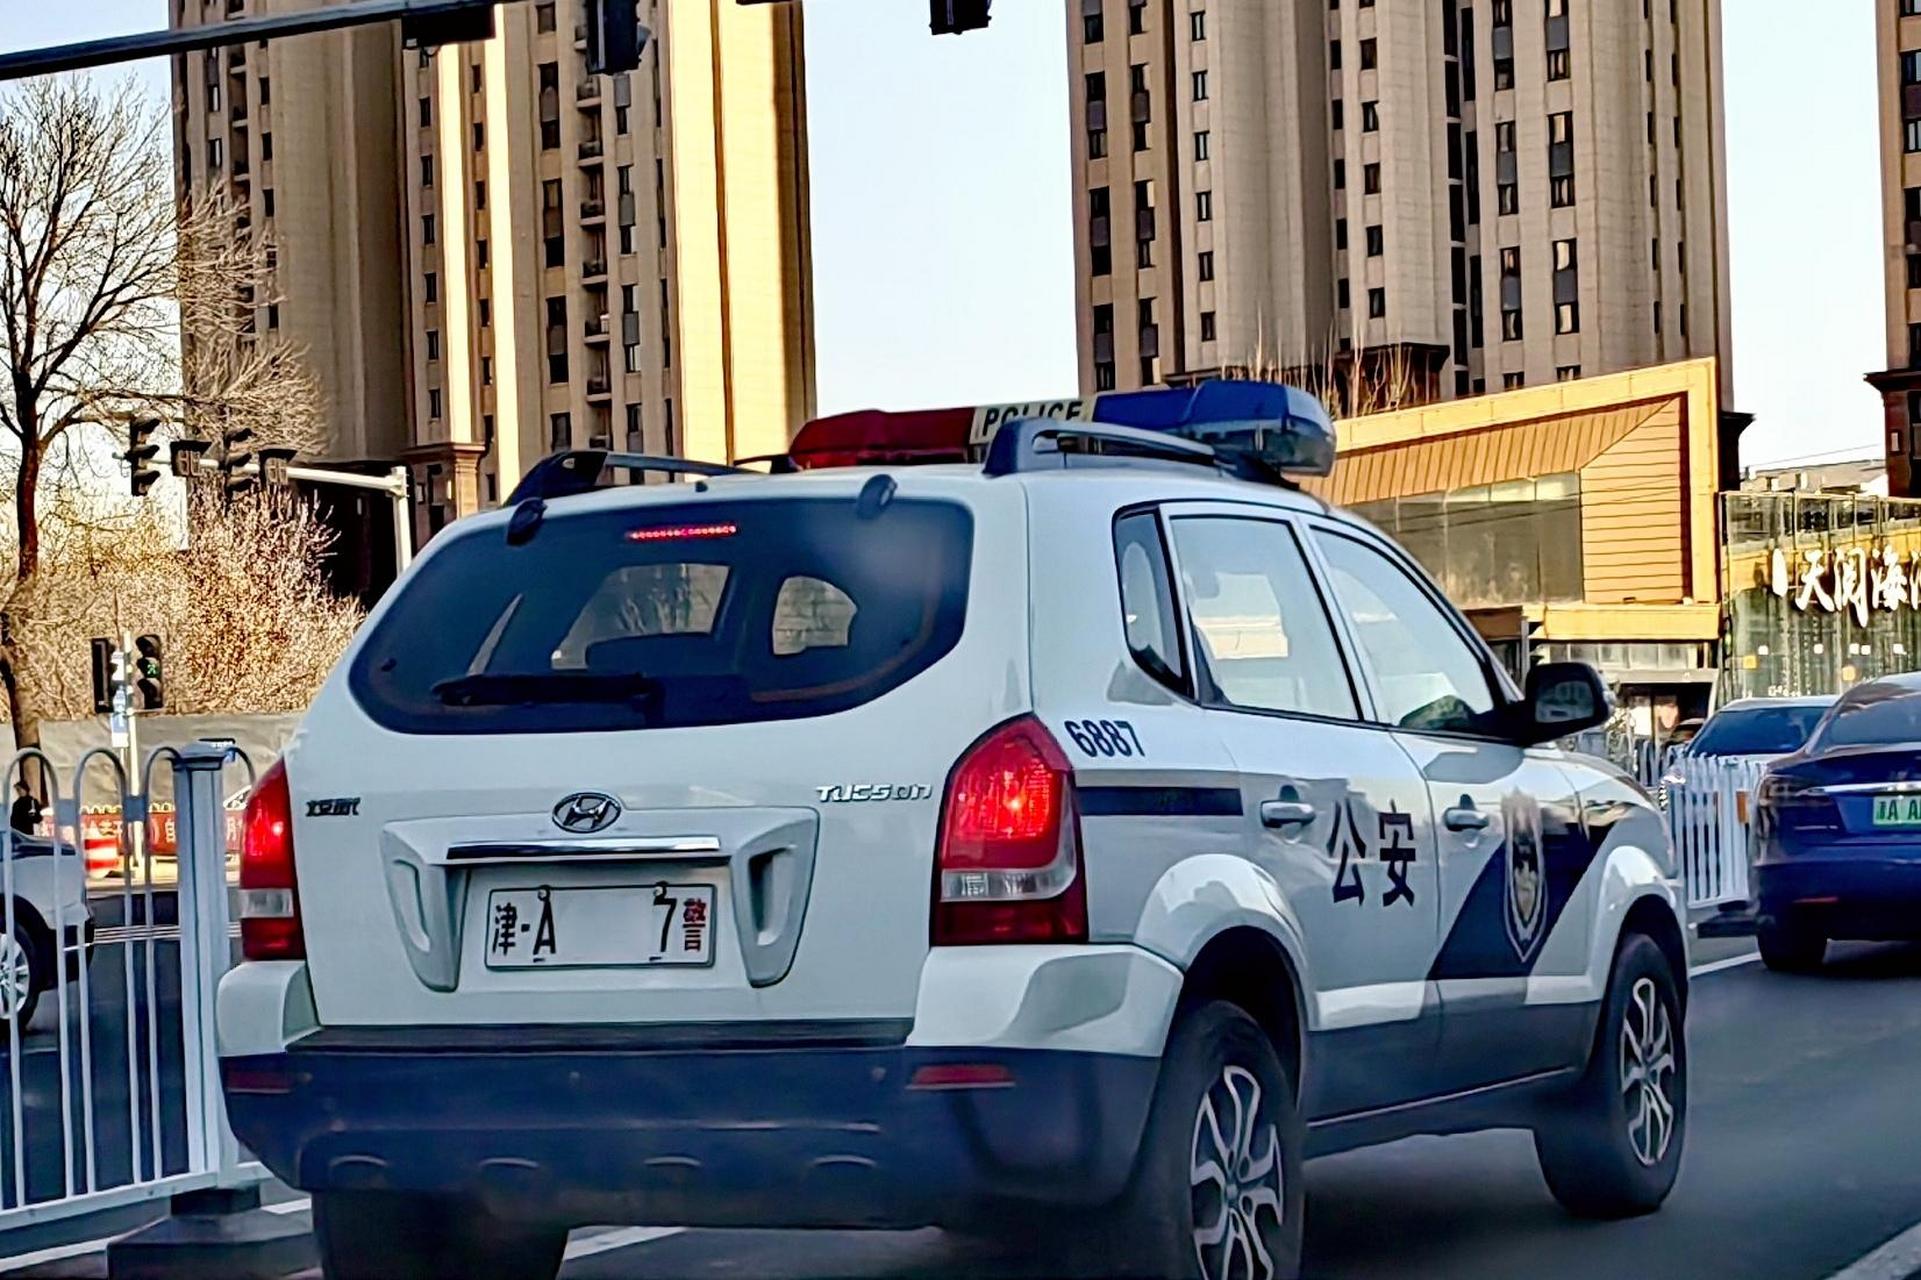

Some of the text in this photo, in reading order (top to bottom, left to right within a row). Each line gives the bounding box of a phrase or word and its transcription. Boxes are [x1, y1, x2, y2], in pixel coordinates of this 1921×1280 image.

[1795, 545, 1921, 628] 天阅海
[1065, 720, 1145, 757] 6887
[1326, 798, 1416, 907] 公安
